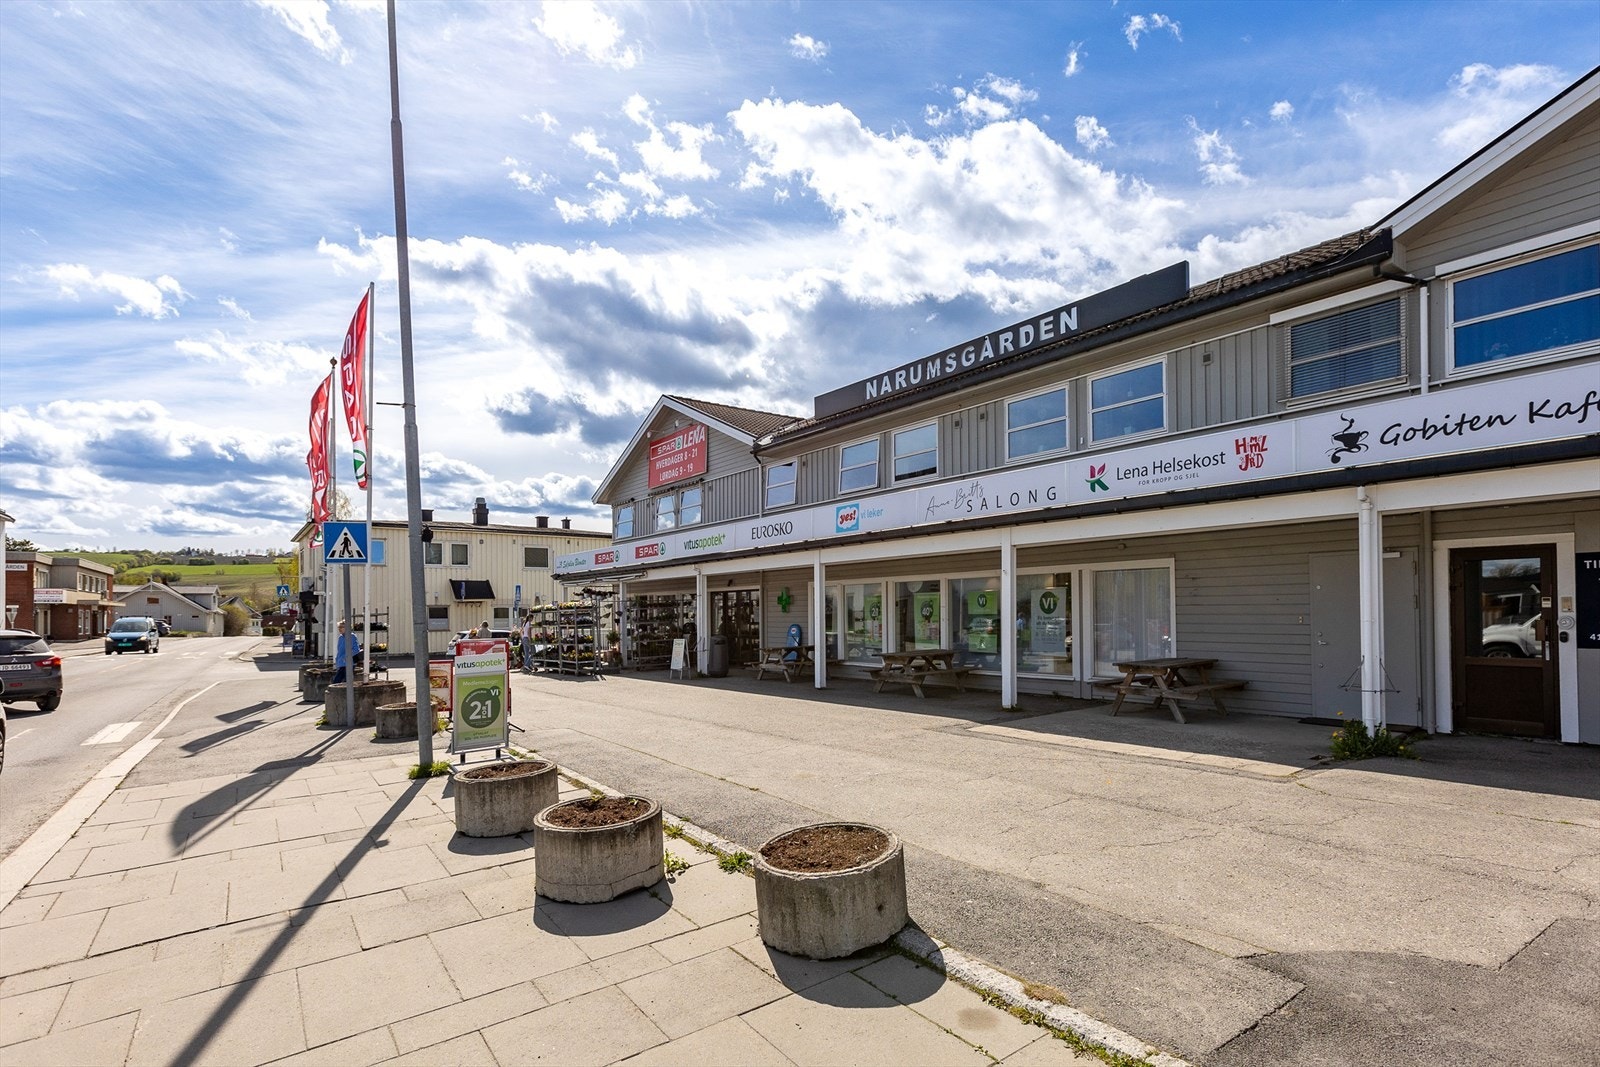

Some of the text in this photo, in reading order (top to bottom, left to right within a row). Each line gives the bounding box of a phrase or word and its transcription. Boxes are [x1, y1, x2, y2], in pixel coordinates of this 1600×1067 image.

[866, 307, 1079, 400] NARUMSGÅRDEN
[1379, 413, 1518, 446] Gobiten
[657, 426, 705, 455] SPAR LENA
[655, 452, 684, 470] HVERDAGER
[691, 448, 698, 458] 21
[1116, 451, 1226, 481] Lena Helsekost
[659, 467, 679, 482] LØRDAG
[687, 463, 694, 473] 19
[1152, 476, 1172, 484] KROPP
[966, 486, 1057, 513] SALONG
[839, 509, 856, 525] yes!
[866, 508, 884, 519] leker
[751, 520, 794, 541] EUROSKO
[597, 552, 614, 563] SPAR
[638, 545, 659, 557] SPAR
[978, 597, 986, 605] VI
[1042, 597, 1054, 609] VI
[469, 700, 482, 720] 2
[485, 700, 493, 718] 1
